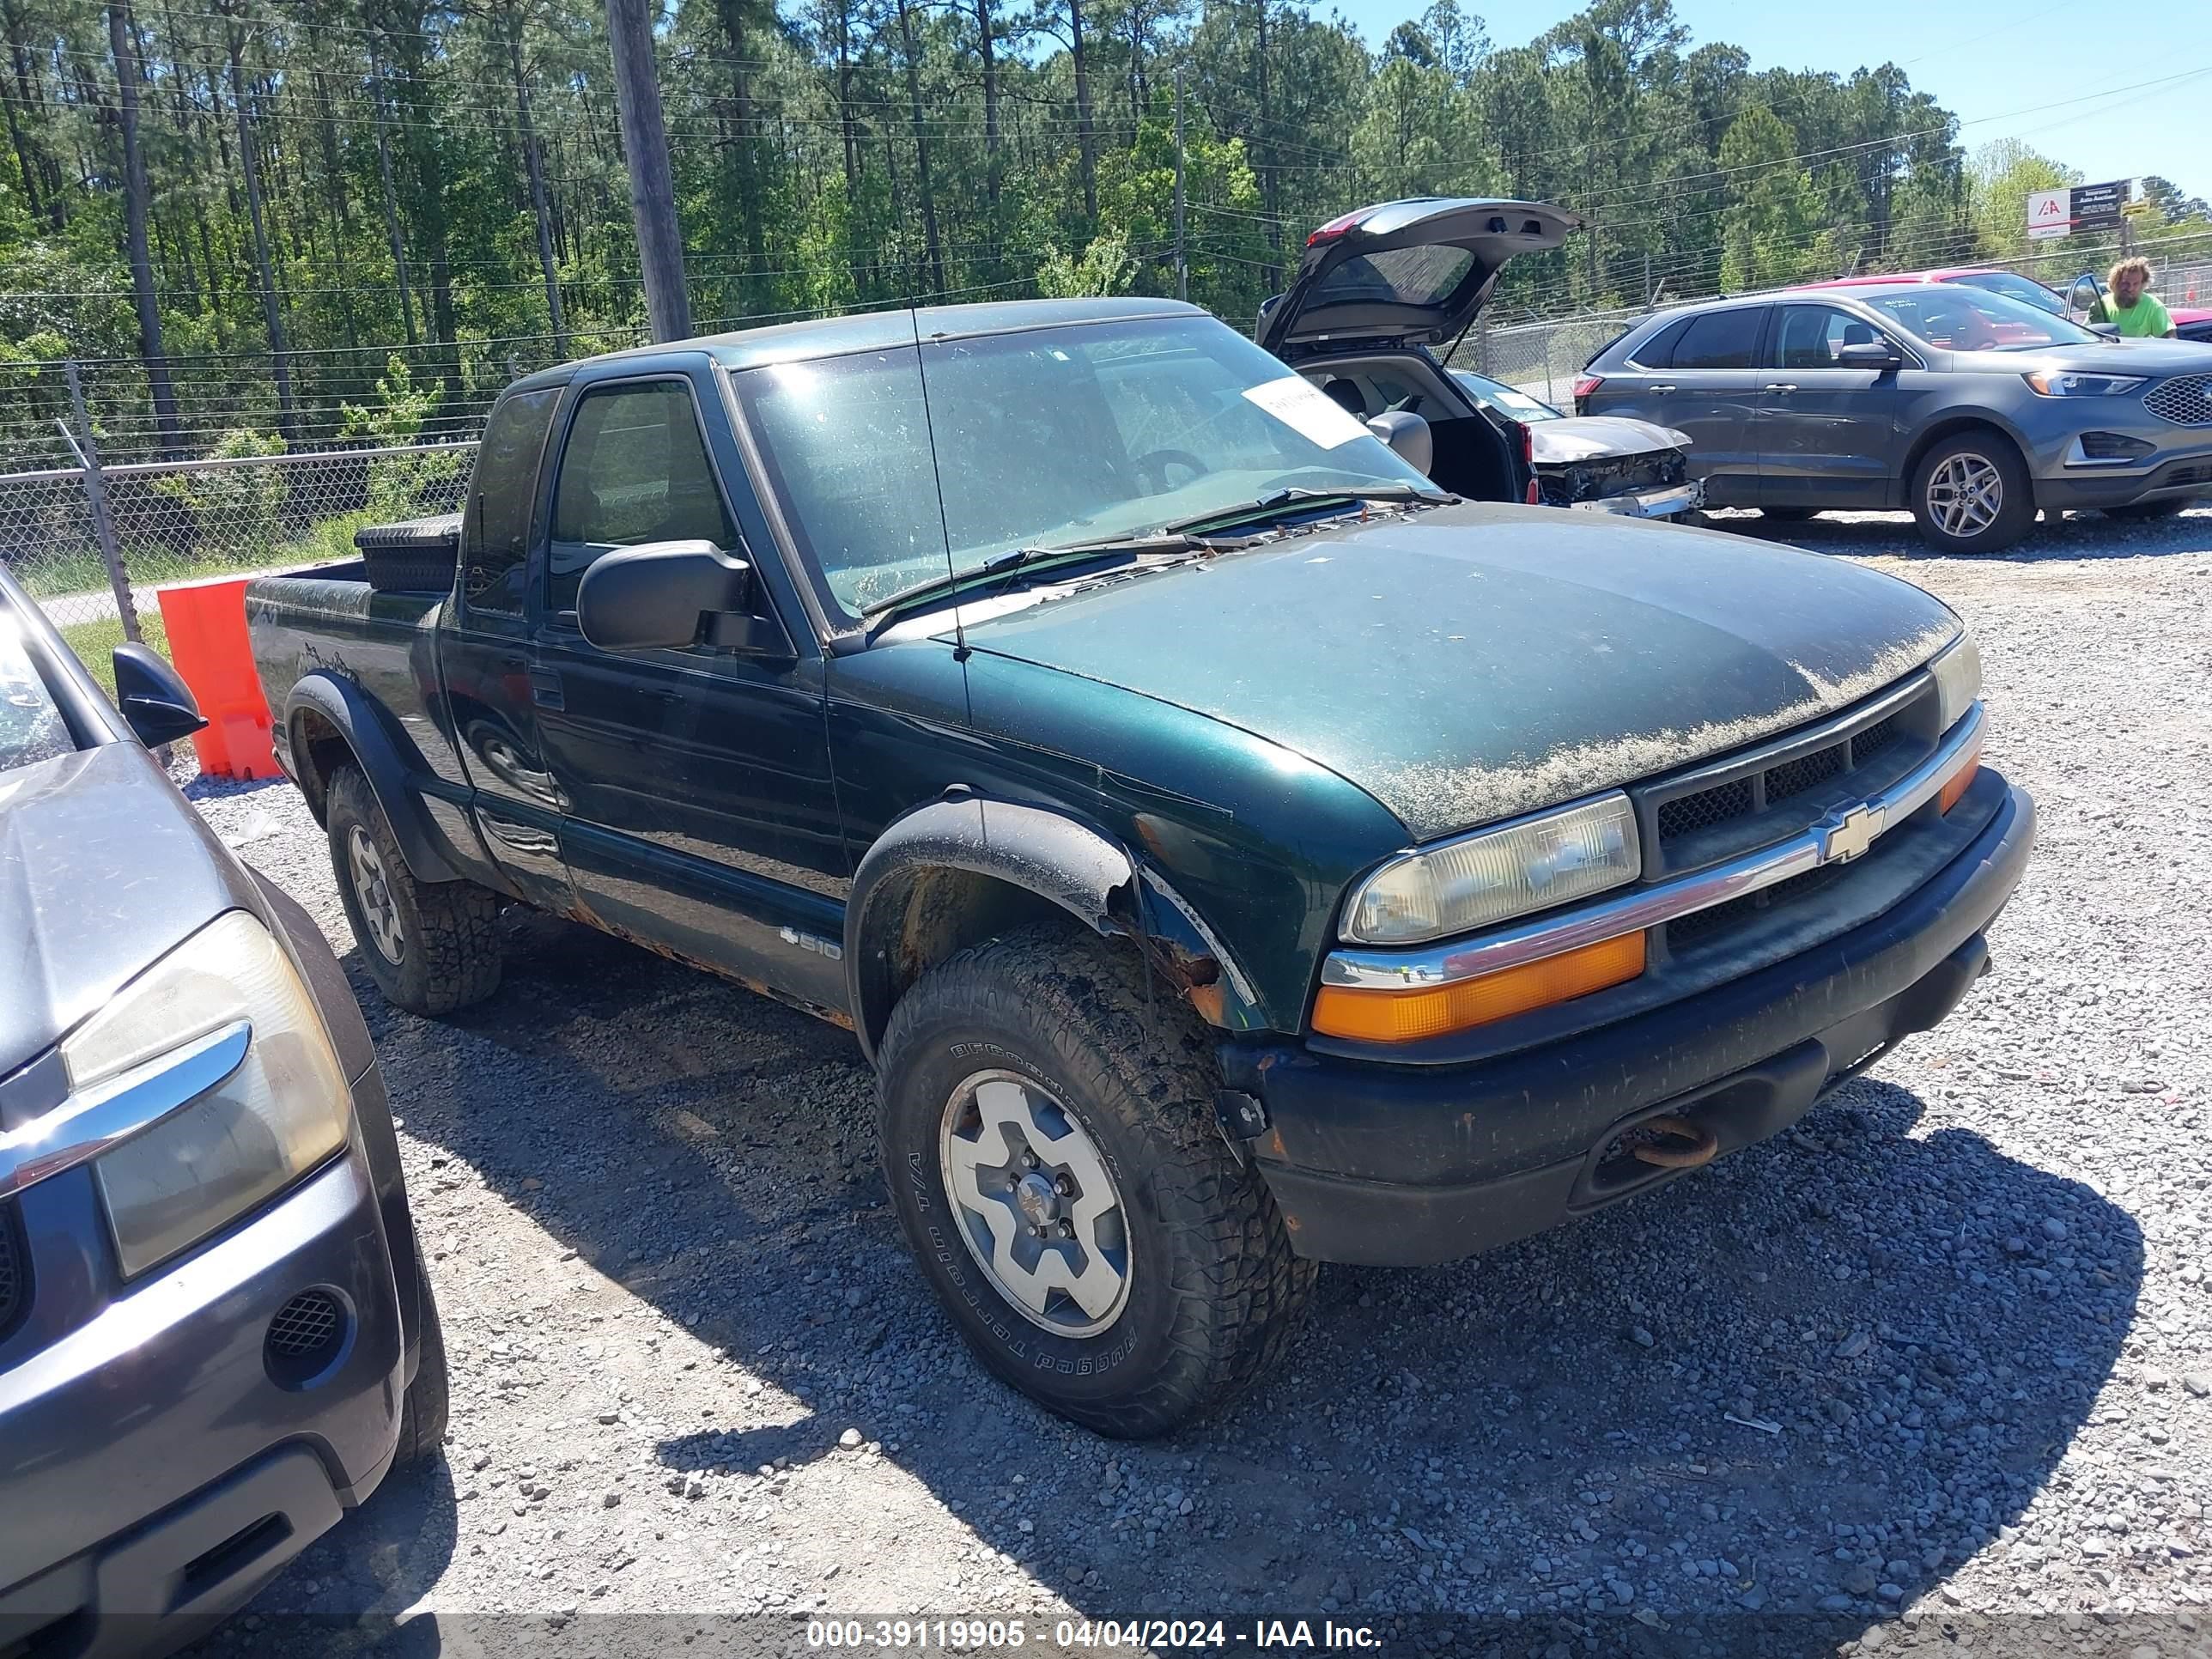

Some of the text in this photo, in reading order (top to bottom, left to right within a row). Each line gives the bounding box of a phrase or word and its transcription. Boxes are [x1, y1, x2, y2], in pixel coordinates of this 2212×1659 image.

[908, 1152, 1139, 1376] Rugged Terrain T/A
